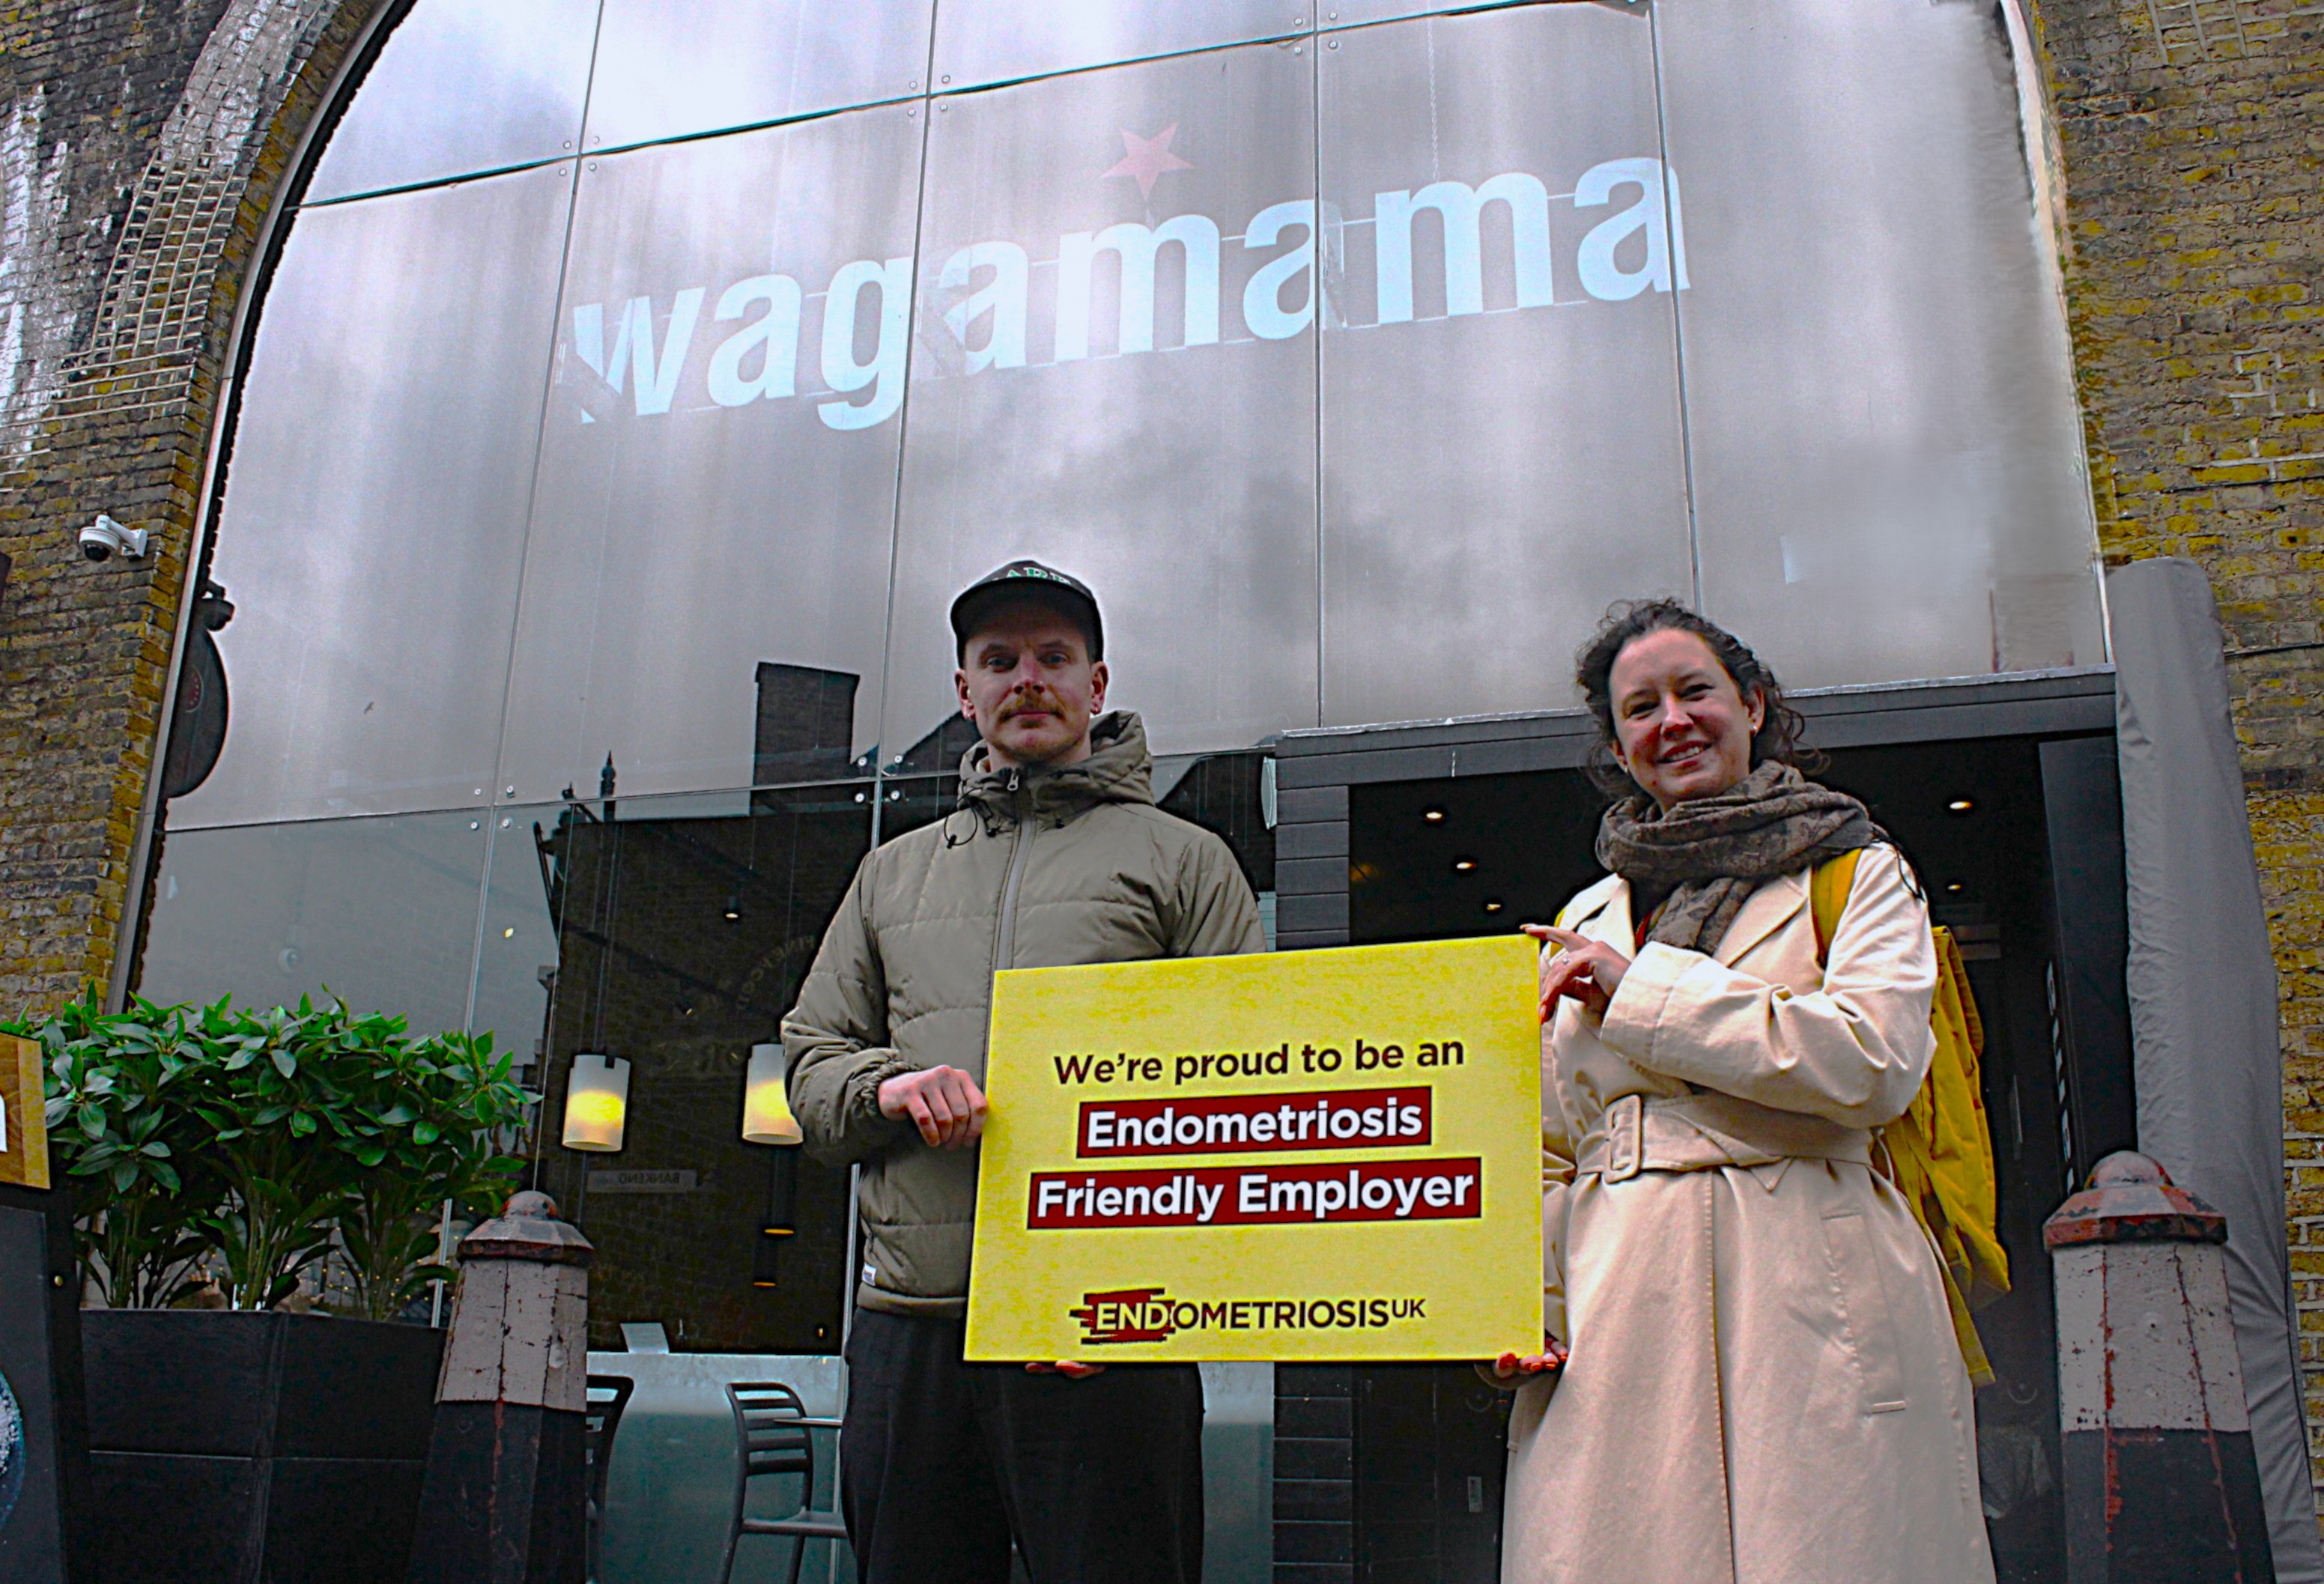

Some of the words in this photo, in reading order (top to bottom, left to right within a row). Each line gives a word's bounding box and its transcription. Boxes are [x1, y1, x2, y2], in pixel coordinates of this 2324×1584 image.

[571, 157, 1690, 431] wagamama
[1055, 1054, 1162, 1084] We’re
[1175, 1044, 1289, 1085] proud
[1302, 1044, 1342, 1073] to
[1356, 1039, 1404, 1069] be
[1418, 1041, 1464, 1066] an
[1087, 1096, 1423, 1148] Endometriosis
[1037, 1176, 1224, 1221] Friendly
[1238, 1170, 1474, 1219] Employer
